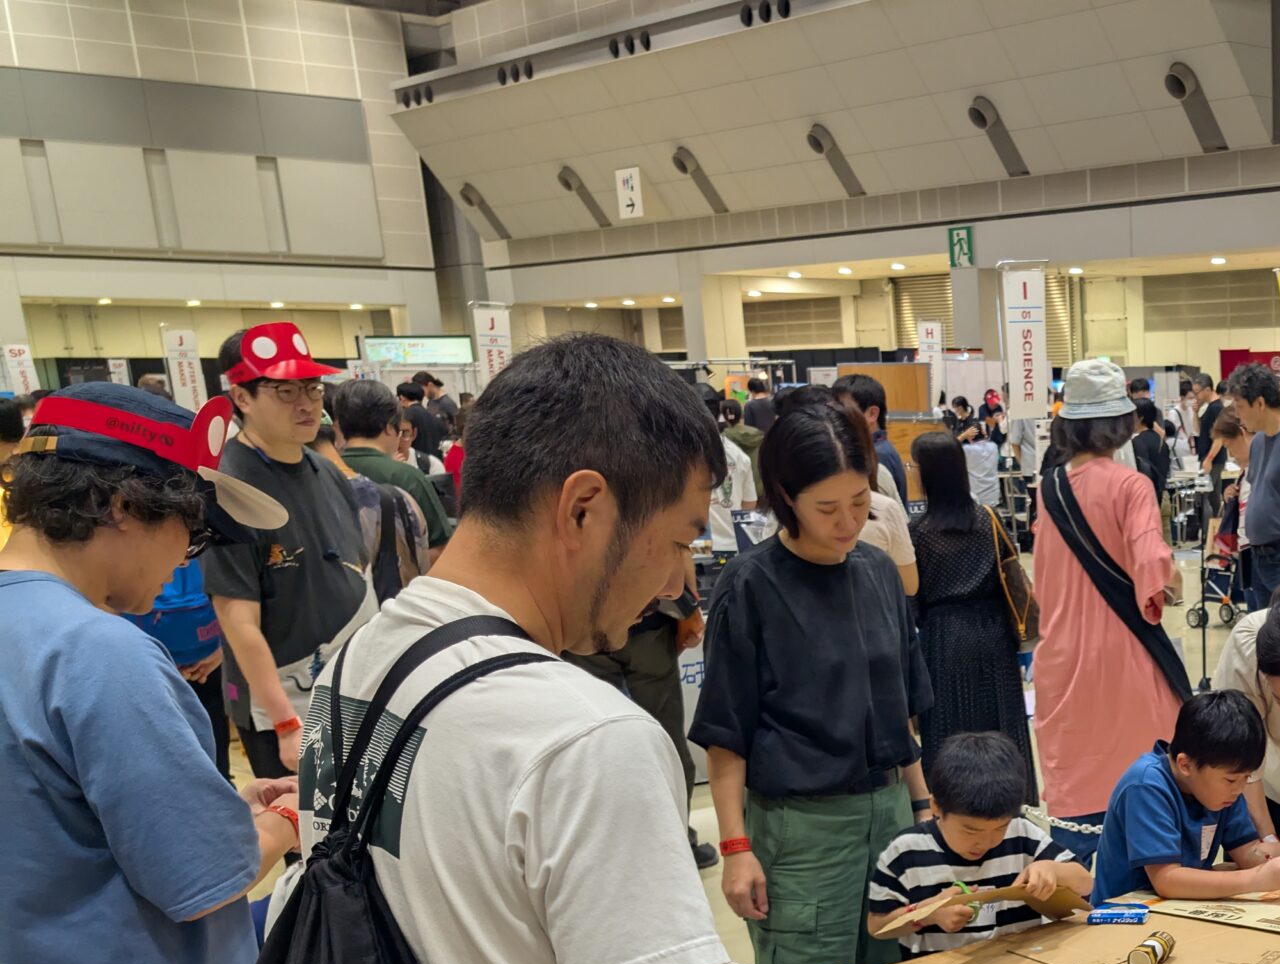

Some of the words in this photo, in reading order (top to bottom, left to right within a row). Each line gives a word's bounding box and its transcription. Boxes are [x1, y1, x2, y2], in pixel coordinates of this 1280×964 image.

[1023, 281, 1027, 300] I
[1021, 310, 1031, 319] 01
[489, 317, 495, 331] J
[926, 328, 934, 339] H
[177, 335, 184, 347] J
[9, 349, 26, 358] SP
[1022, 329, 1034, 402] SCIENCE
[105, 416, 158, 443] @nifty
